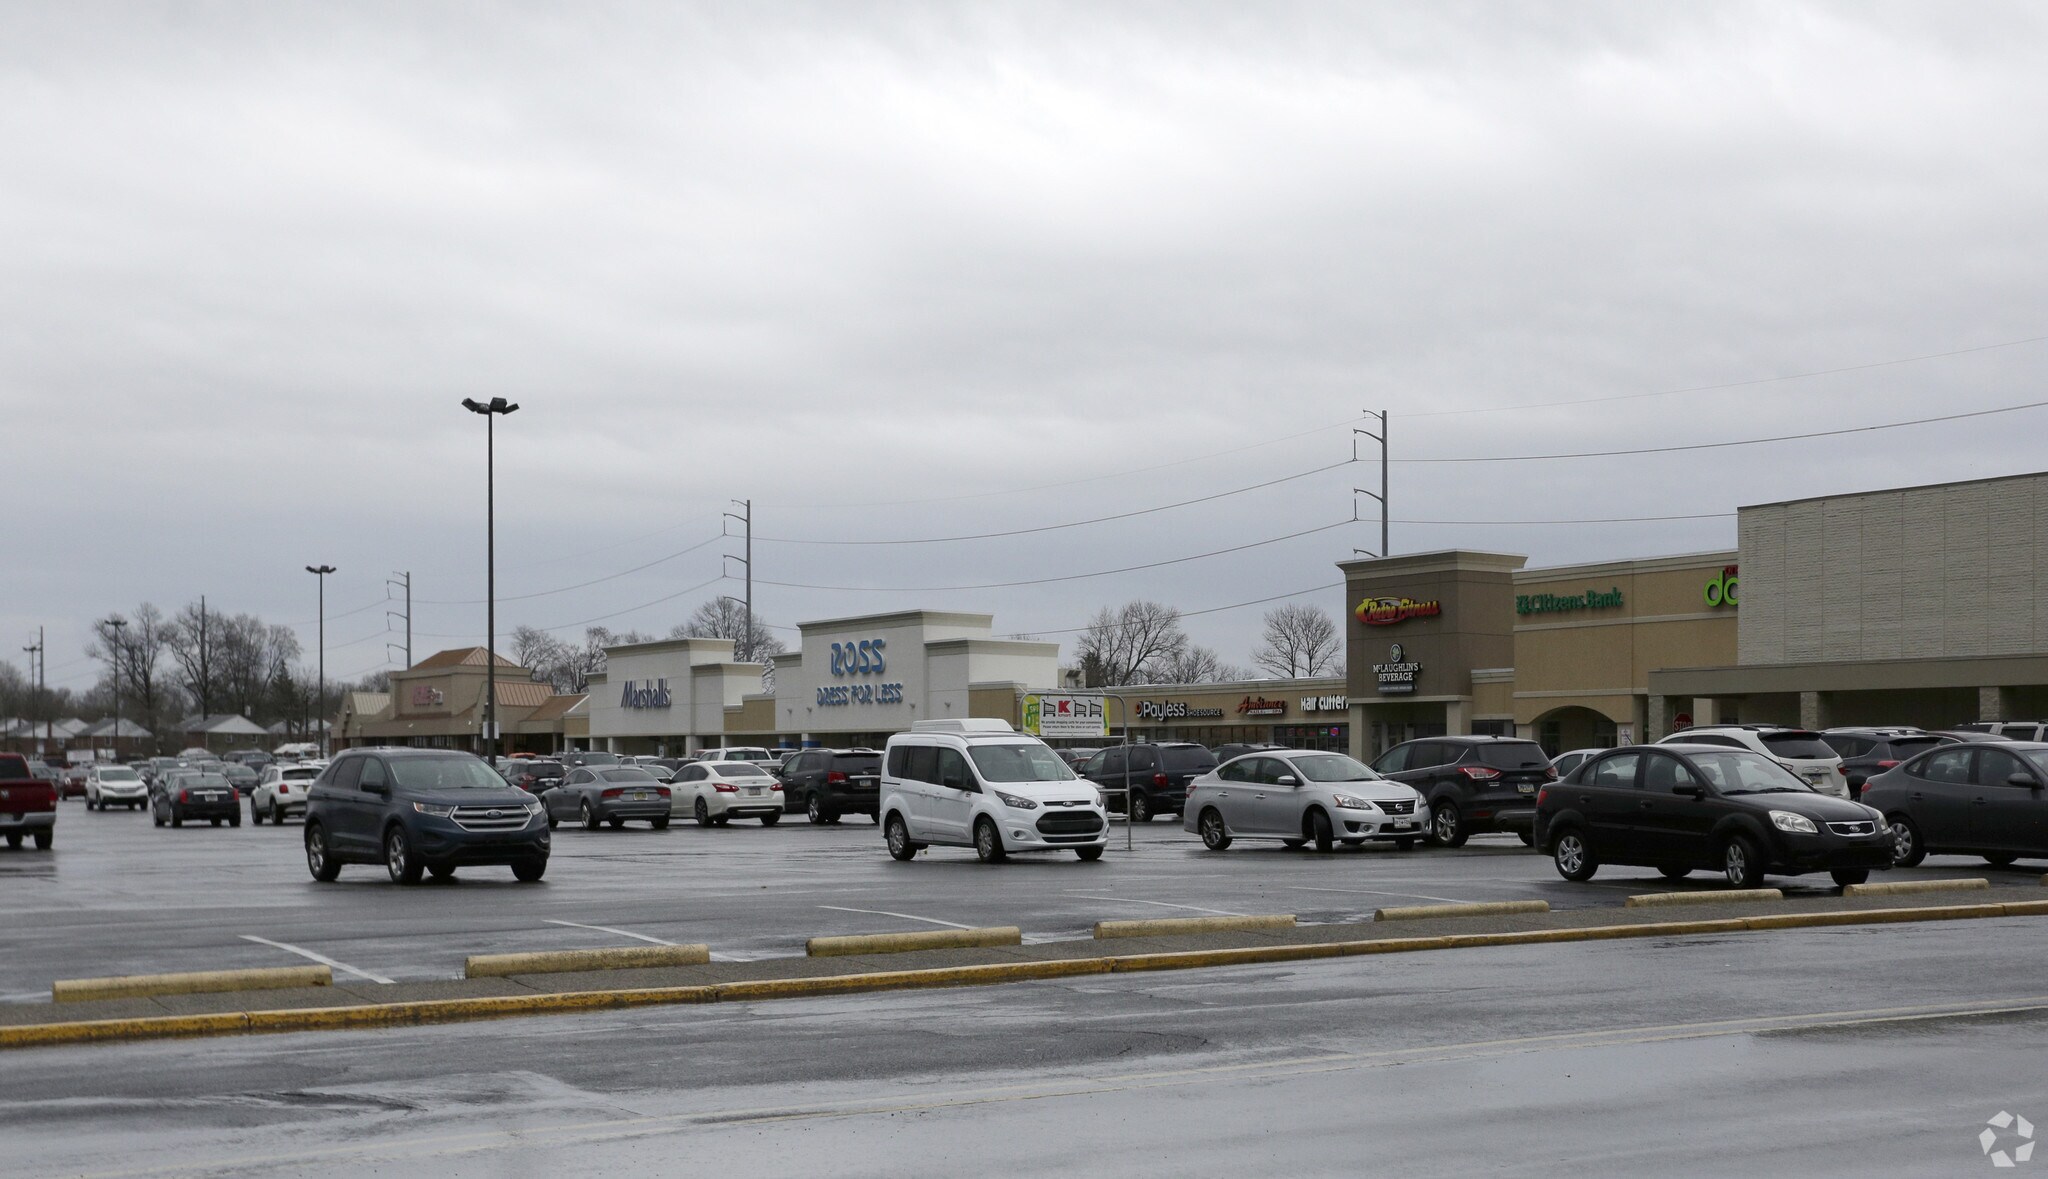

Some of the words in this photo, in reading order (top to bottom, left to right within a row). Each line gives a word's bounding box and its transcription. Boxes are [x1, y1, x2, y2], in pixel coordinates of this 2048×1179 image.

[1529, 593, 1585, 610] Citizens
[1586, 587, 1623, 608] Bank
[1368, 601, 1396, 621] Retro
[1398, 599, 1439, 618] Fitness
[831, 639, 885, 675] ROSS
[1378, 672, 1413, 682] BEVERAGE
[621, 678, 671, 709] Marshalls
[817, 686, 849, 706] DRESS
[851, 684, 873, 704] FOR
[875, 683, 903, 704] LESS
[1300, 697, 1317, 711] Hair
[1058, 701, 1071, 713] K
[1143, 701, 1186, 722] Payless
